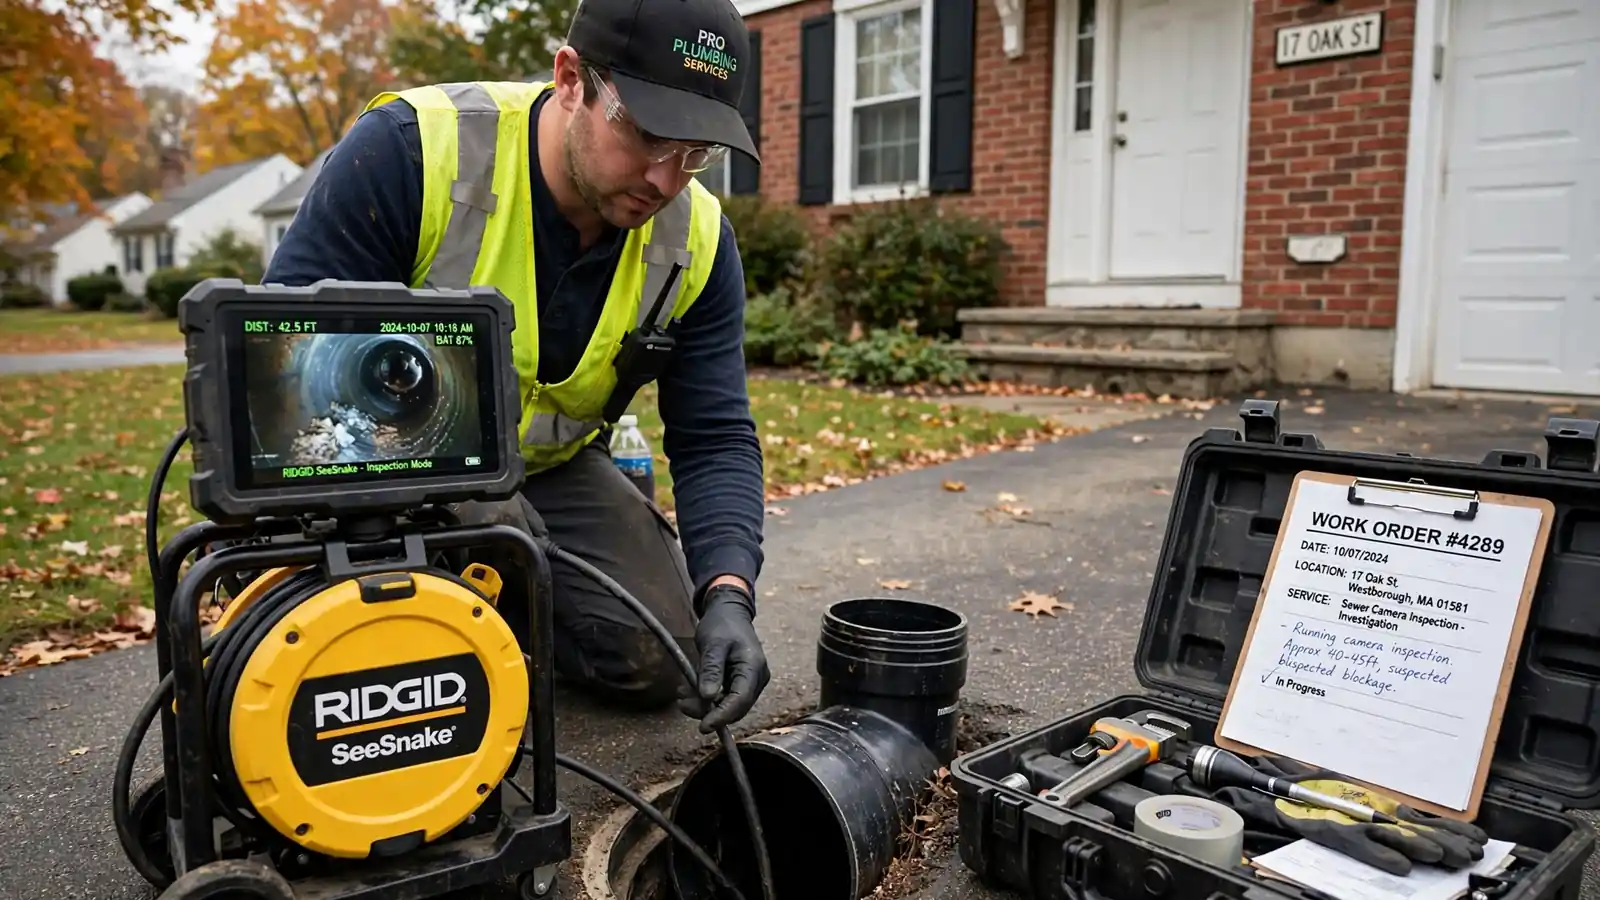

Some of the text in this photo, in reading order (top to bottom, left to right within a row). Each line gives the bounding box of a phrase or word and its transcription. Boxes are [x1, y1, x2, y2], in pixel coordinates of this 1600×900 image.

[697, 29, 726, 51] PRO
[1283, 20, 1374, 57] 17 OAK ST
[672, 38, 737, 72] PLUMBING
[683, 57, 729, 80] SERVICES
[244, 321, 317, 333] DIST: 42.5 FT
[380, 322, 430, 333] 2024-10-07
[460, 322, 474, 333] AM
[436, 335, 473, 345] BAT 87%
[282, 466, 315, 478] RIDGID
[316, 463, 358, 476] SeeSnake
[366, 461, 409, 474] Inspection
[411, 459, 433, 469] Mode
[1311, 511, 1505, 555] WORK ORDER #4289
[1300, 540, 1389, 564] DATE: 10/07/2024
[1295, 560, 1347, 578] LOCATION:
[1351, 570, 1363, 581] 17
[1365, 572, 1385, 585] Oak
[1287, 588, 1332, 606] SERVICE:
[1341, 598, 1370, 614] Sewer
[1371, 605, 1407, 621] Camera
[1408, 612, 1459, 632] Inspection
[1348, 582, 1469, 614] Westborough, MA 01581
[1338, 611, 1399, 632] Investigation
[1292, 621, 1337, 646] Running
[1343, 635, 1384, 651] camera
[1391, 642, 1453, 666] inspection.
[1283, 638, 1452, 685] Approx 40-45ft, suspected
[1275, 676, 1326, 698] In Progress
[1342, 668, 1397, 695] blockage.
[314, 672, 467, 728] RIDGID
[331, 726, 457, 765] SeeSnake
